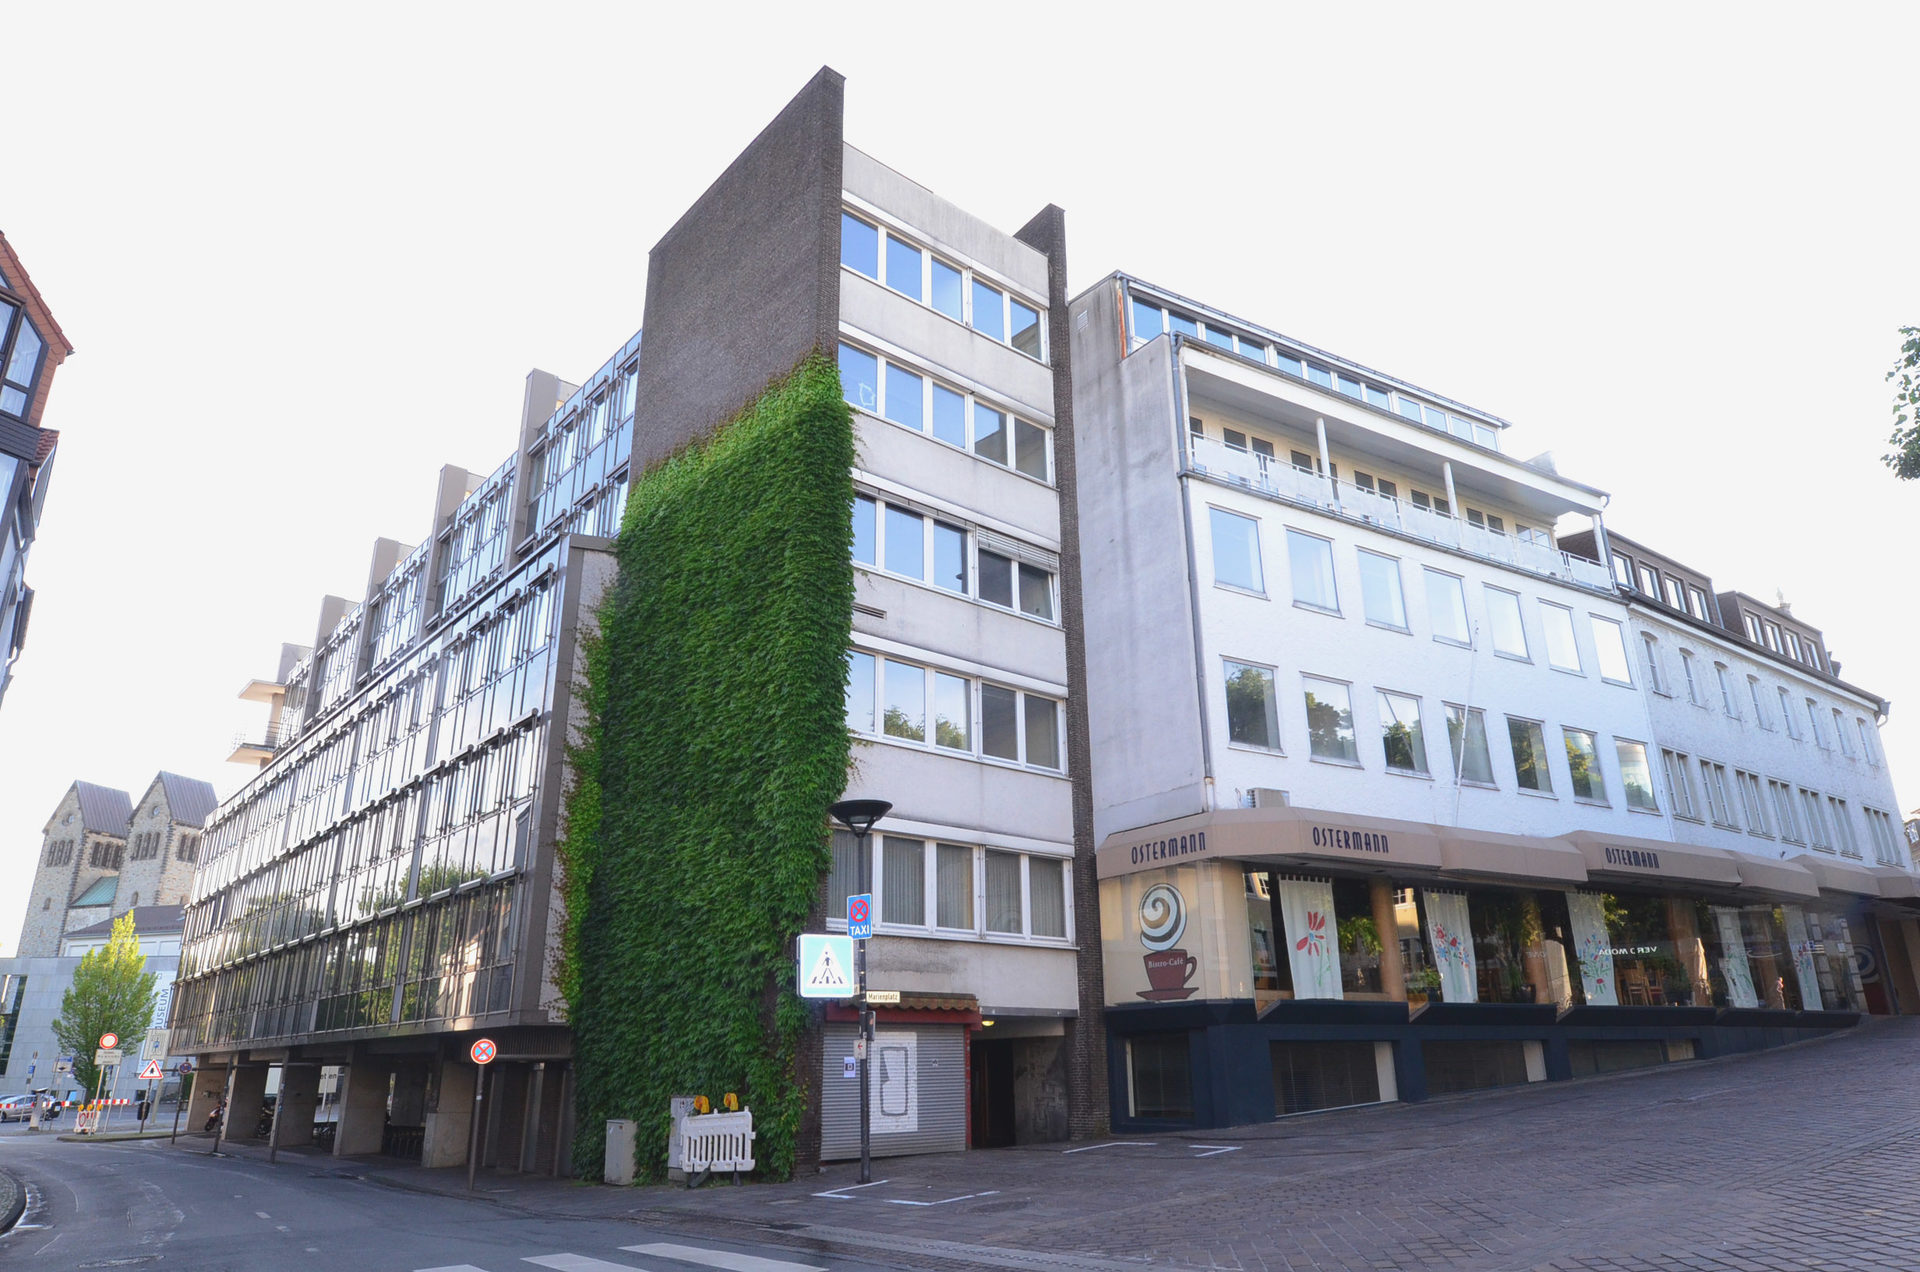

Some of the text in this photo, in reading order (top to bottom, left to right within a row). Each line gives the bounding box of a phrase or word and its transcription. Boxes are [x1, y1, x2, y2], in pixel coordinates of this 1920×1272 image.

[1131, 832, 1206, 864] OSTERMANN
[1313, 826, 1389, 853] OSTERMANN
[1605, 847, 1660, 869] OSTERMANN
[849, 924, 870, 936] TAXI
[155, 988, 169, 1029] USEUM
[868, 992, 898, 1002] Marienplatz
